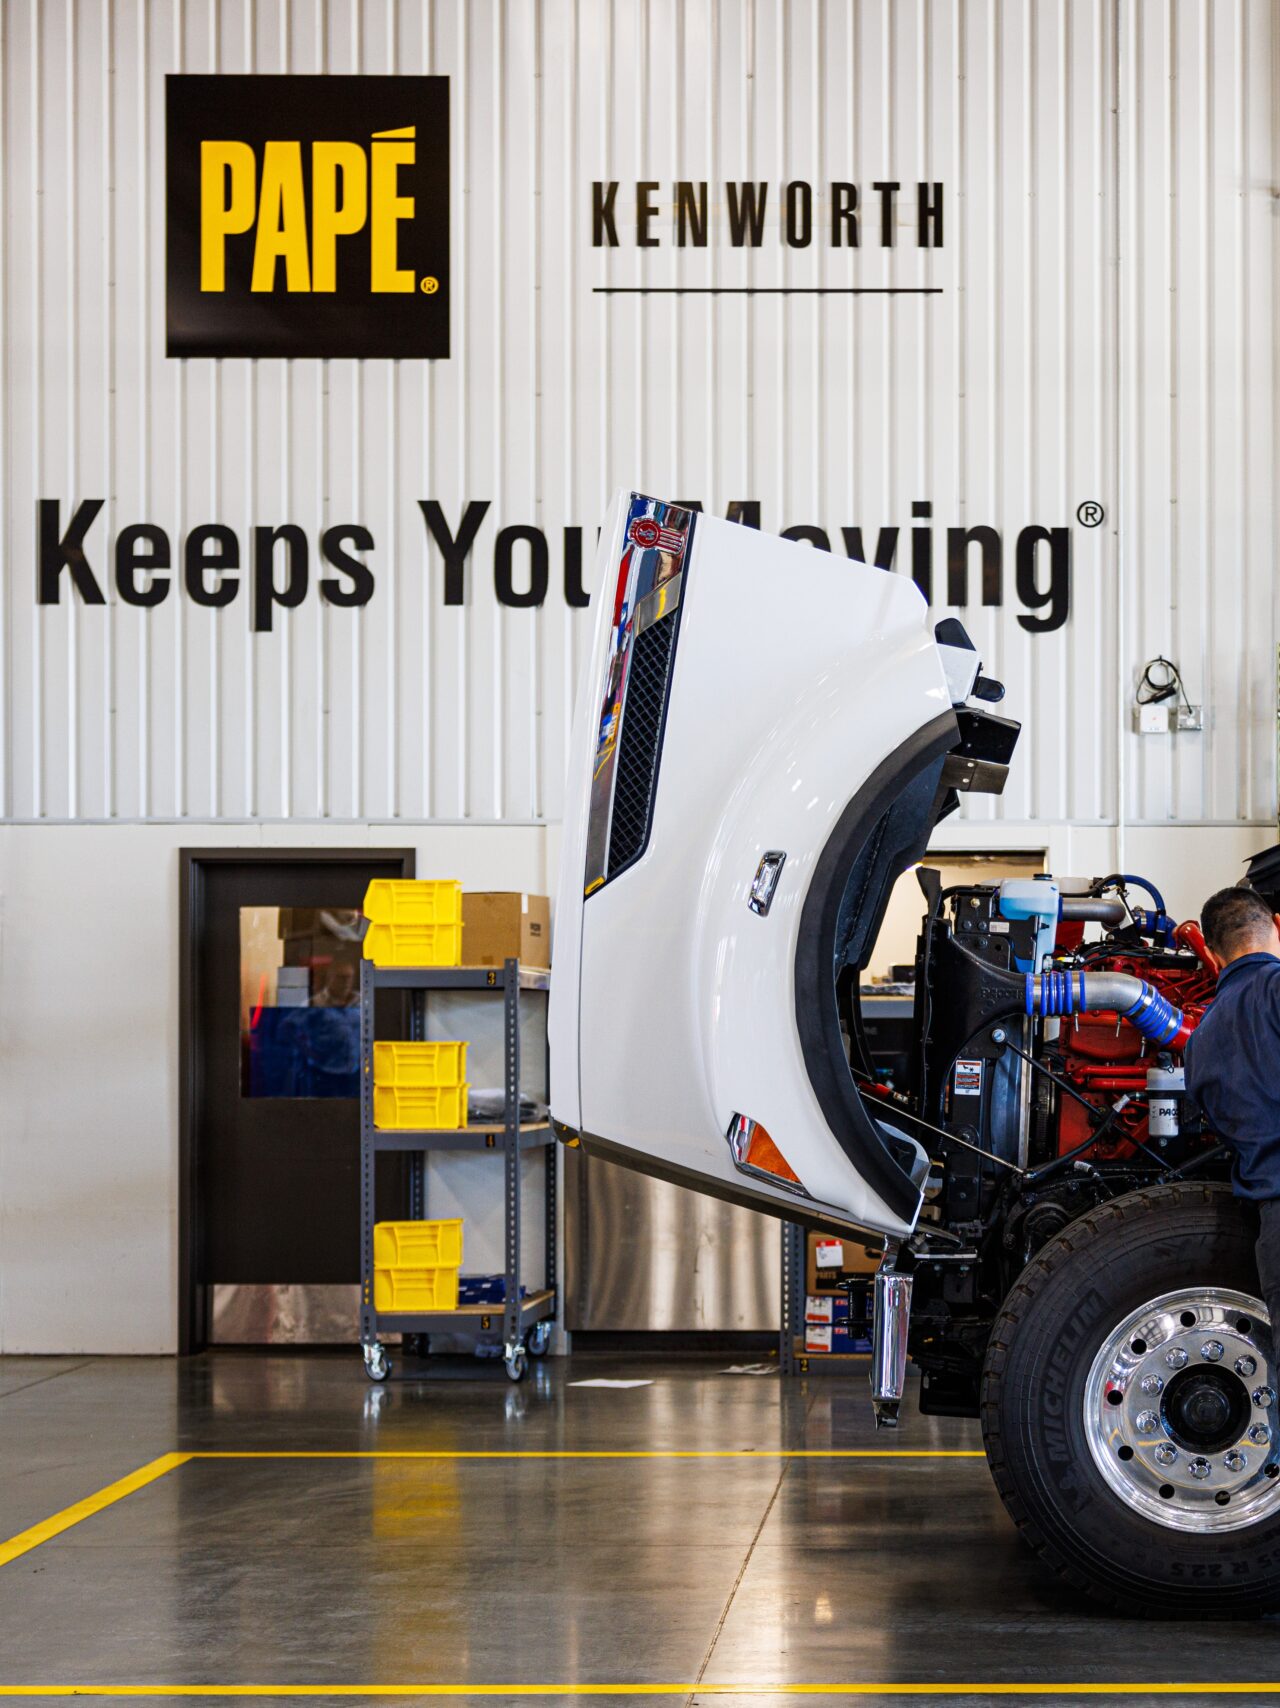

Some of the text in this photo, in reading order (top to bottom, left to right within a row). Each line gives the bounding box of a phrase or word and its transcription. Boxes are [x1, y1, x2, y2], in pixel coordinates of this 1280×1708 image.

[591, 181, 944, 248] KENWORTH
[36, 498, 375, 632] Keeps
[1042, 1292, 1108, 1463] MICHELIN
